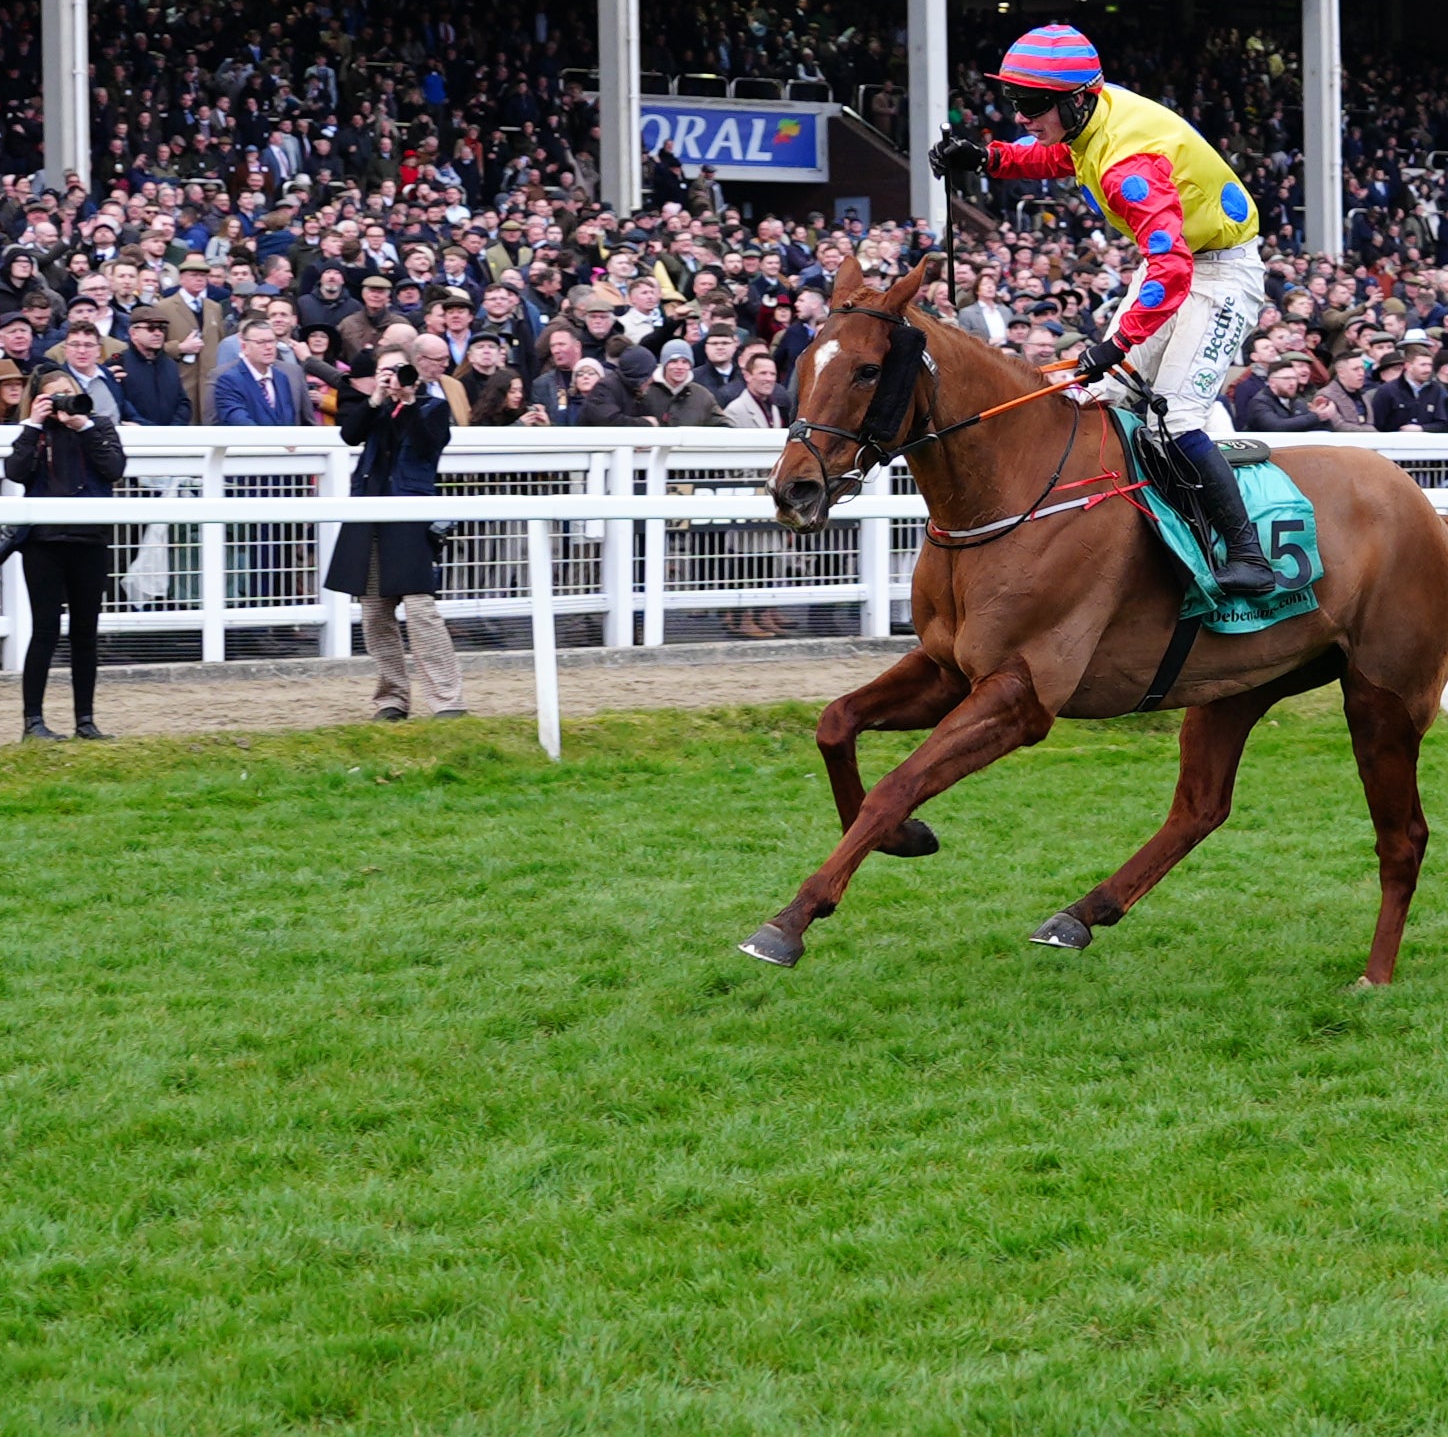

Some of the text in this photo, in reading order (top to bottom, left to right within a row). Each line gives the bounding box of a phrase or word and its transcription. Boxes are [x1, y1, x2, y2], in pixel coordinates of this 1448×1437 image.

[640, 113, 773, 162] ORAL
[1203, 296, 1236, 365] Bective
[1223, 312, 1246, 358] Stud
[1250, 519, 1313, 590] 5
